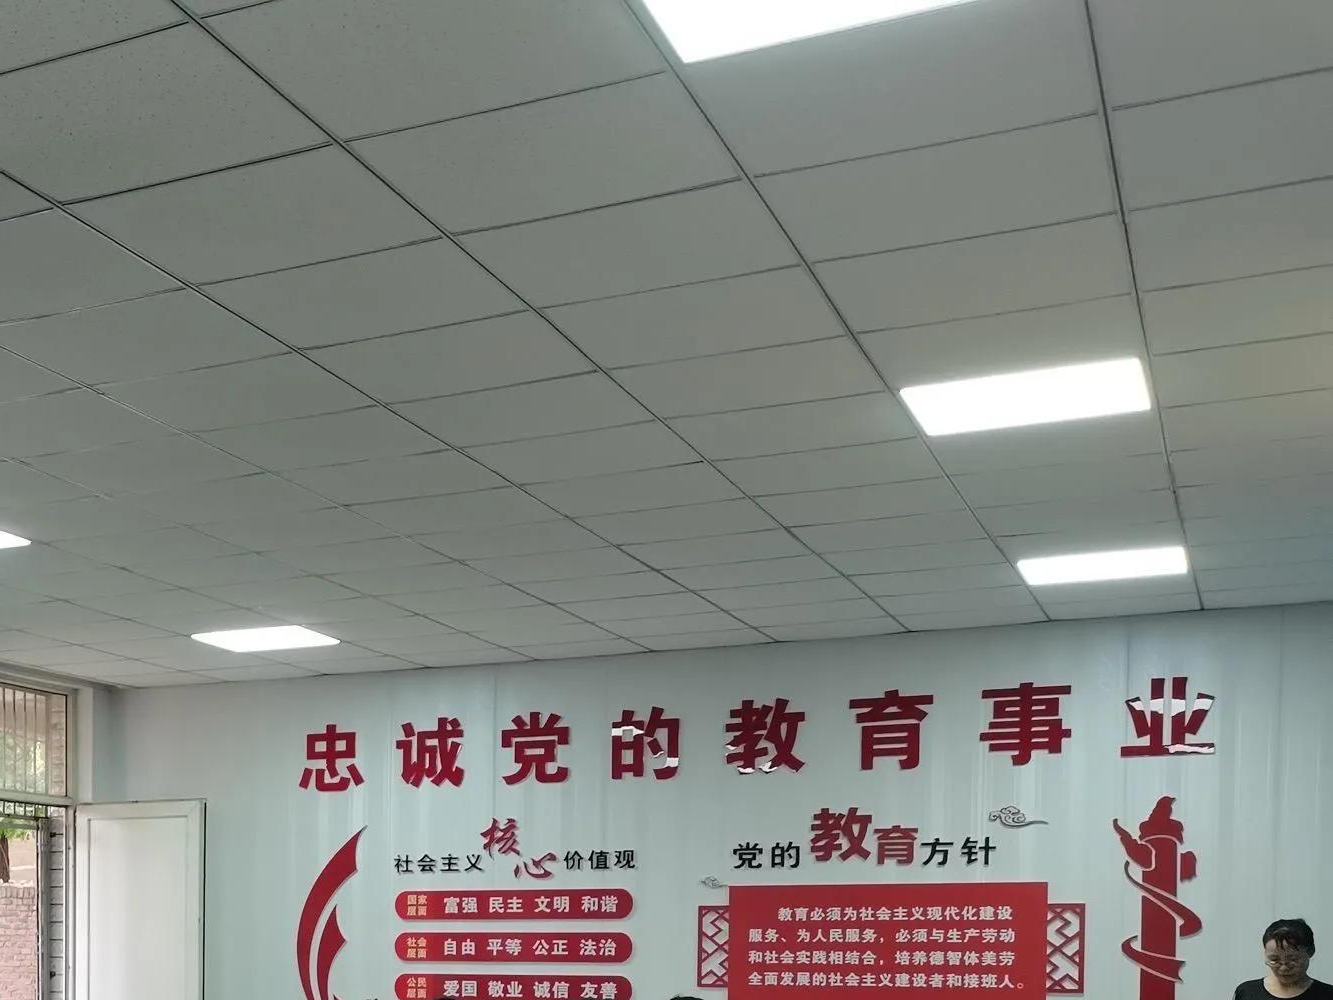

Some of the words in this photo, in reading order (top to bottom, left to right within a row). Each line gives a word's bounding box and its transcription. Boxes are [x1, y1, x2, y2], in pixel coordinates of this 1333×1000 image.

[299, 676, 1216, 792] 忠诚党的教育事业
[732, 807, 996, 869] 党的教育方针
[394, 818, 635, 879] 社会主义核心价值观
[444, 897, 478, 914] 富强
[489, 896, 523, 913] 民主
[534, 896, 570, 913] 文明
[581, 895, 618, 913] 和谐
[778, 906, 1013, 921] 教育必须为社会主义现代化建设
[407, 937, 427, 947] 社会
[444, 939, 476, 956] 自由
[487, 938, 522, 956] 平等
[533, 939, 568, 956] 公正
[580, 939, 617, 956] 法治
[407, 977, 427, 988] 公民
[444, 980, 477, 997] 爱国
[488, 981, 523, 998] 敬业
[534, 981, 570, 998] 诚信
[581, 982, 618, 999] 友善
[748, 972, 1024, 989] 全面发展的社会主义建设者和接班人。
